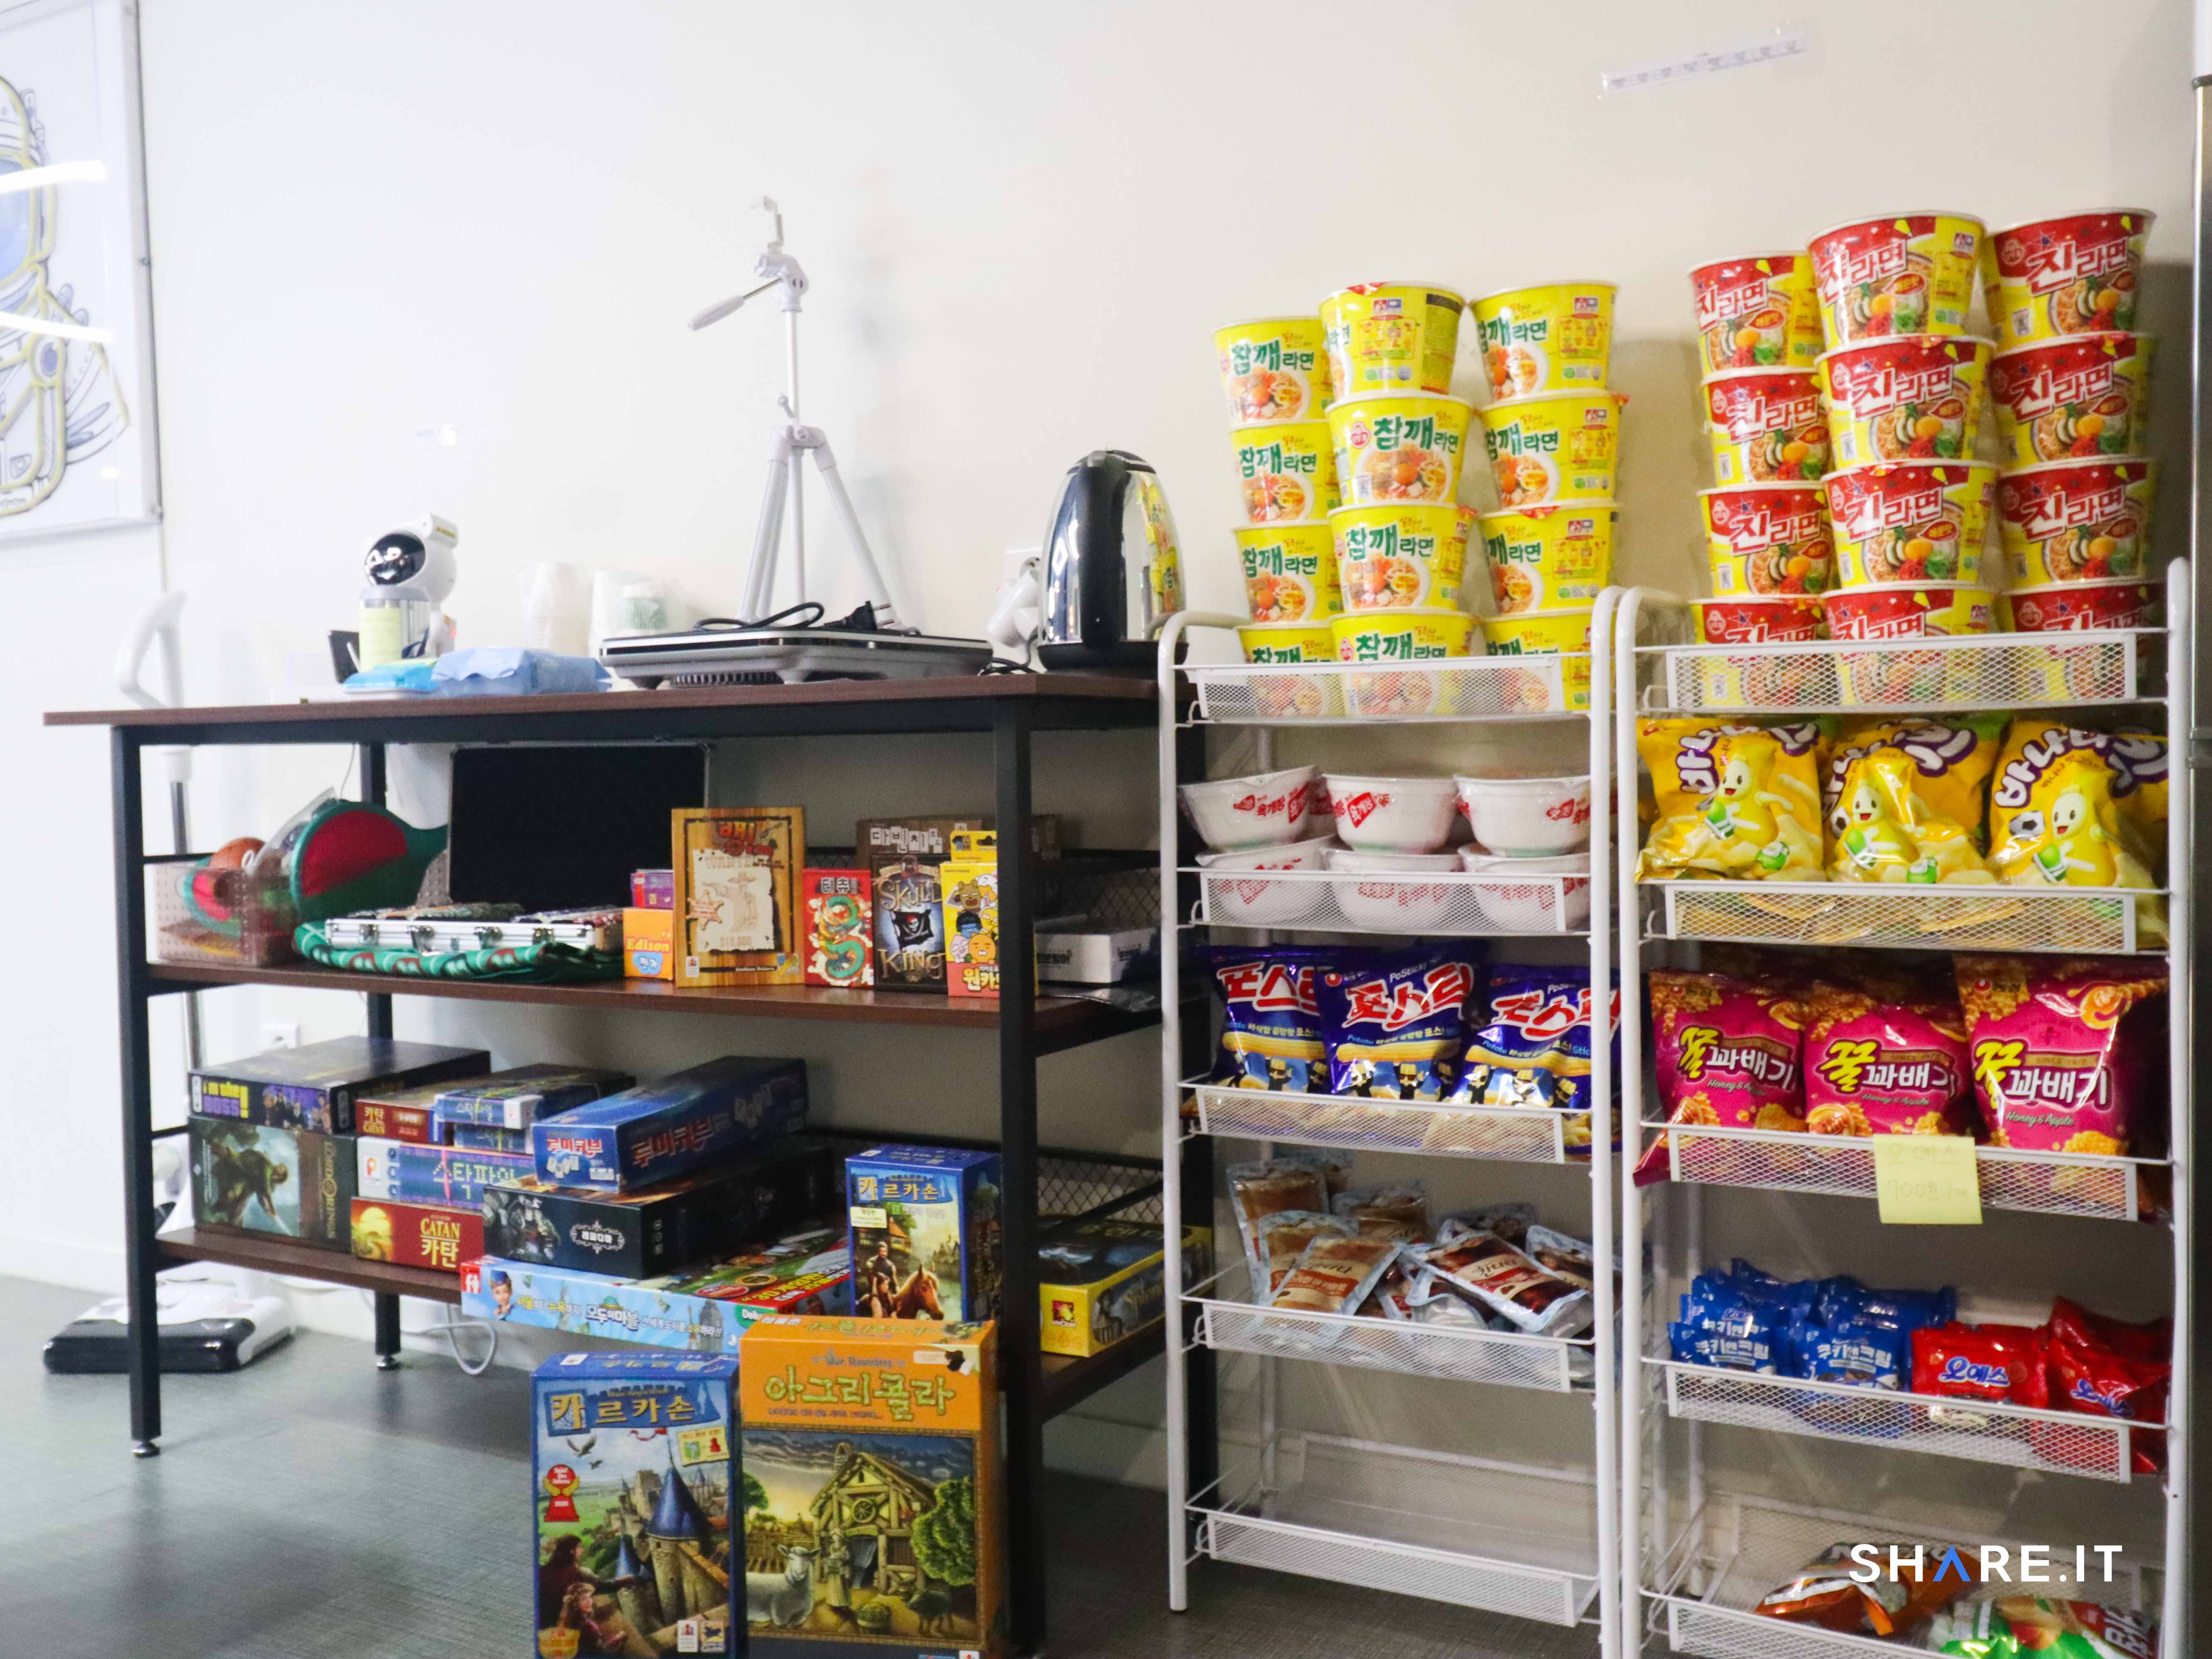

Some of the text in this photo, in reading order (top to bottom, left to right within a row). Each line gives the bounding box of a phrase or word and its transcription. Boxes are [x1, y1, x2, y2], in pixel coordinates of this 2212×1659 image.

[2027, 237, 2128, 297] 진라면
[1231, 339, 1314, 376] 참깨라면
[1852, 365, 1954, 421] 진라면
[2012, 362, 2115, 423] 진라면
[1373, 416, 1459, 454] 참깨라면
[1727, 394, 1819, 445] 진라면
[1239, 443, 1317, 476] 참깨라면
[1728, 507, 1821, 556] 진라면
[1845, 487, 1942, 544] 진라면
[2021, 485, 2126, 542] 진라면
[1346, 524, 1434, 561] 참깨라면
[1488, 534, 1541, 565] 깨라면
[1241, 545, 1318, 578] 참깨라면
[626, 938, 670, 952] Edison
[963, 968, 999, 992] 원카
[1342, 962, 1474, 1031] 포스틱
[1572, 1046, 1591, 1056] Stic
[1680, 1027, 1793, 1089] 꿀꽈배기
[1820, 1041, 1955, 1098] 꿀꽈배기
[2006, 1112, 2036, 1128] Honey
[2044, 1114, 2074, 1126] Apple
[546, 1138, 603, 1158] 루미큐브
[631, 1119, 713, 1168] 루미큐브
[858, 1177, 939, 1201] 카르카손
[420, 1218, 460, 1240] CATAN
[421, 1240, 459, 1268] 카탄
[1695, 1338, 1769, 1360] 쿠키앤크림
[1817, 1343, 1892, 1368] 쿠키앤크림
[550, 1393, 695, 1430] 카르카손
[765, 1364, 956, 1422] 아그리콜라
